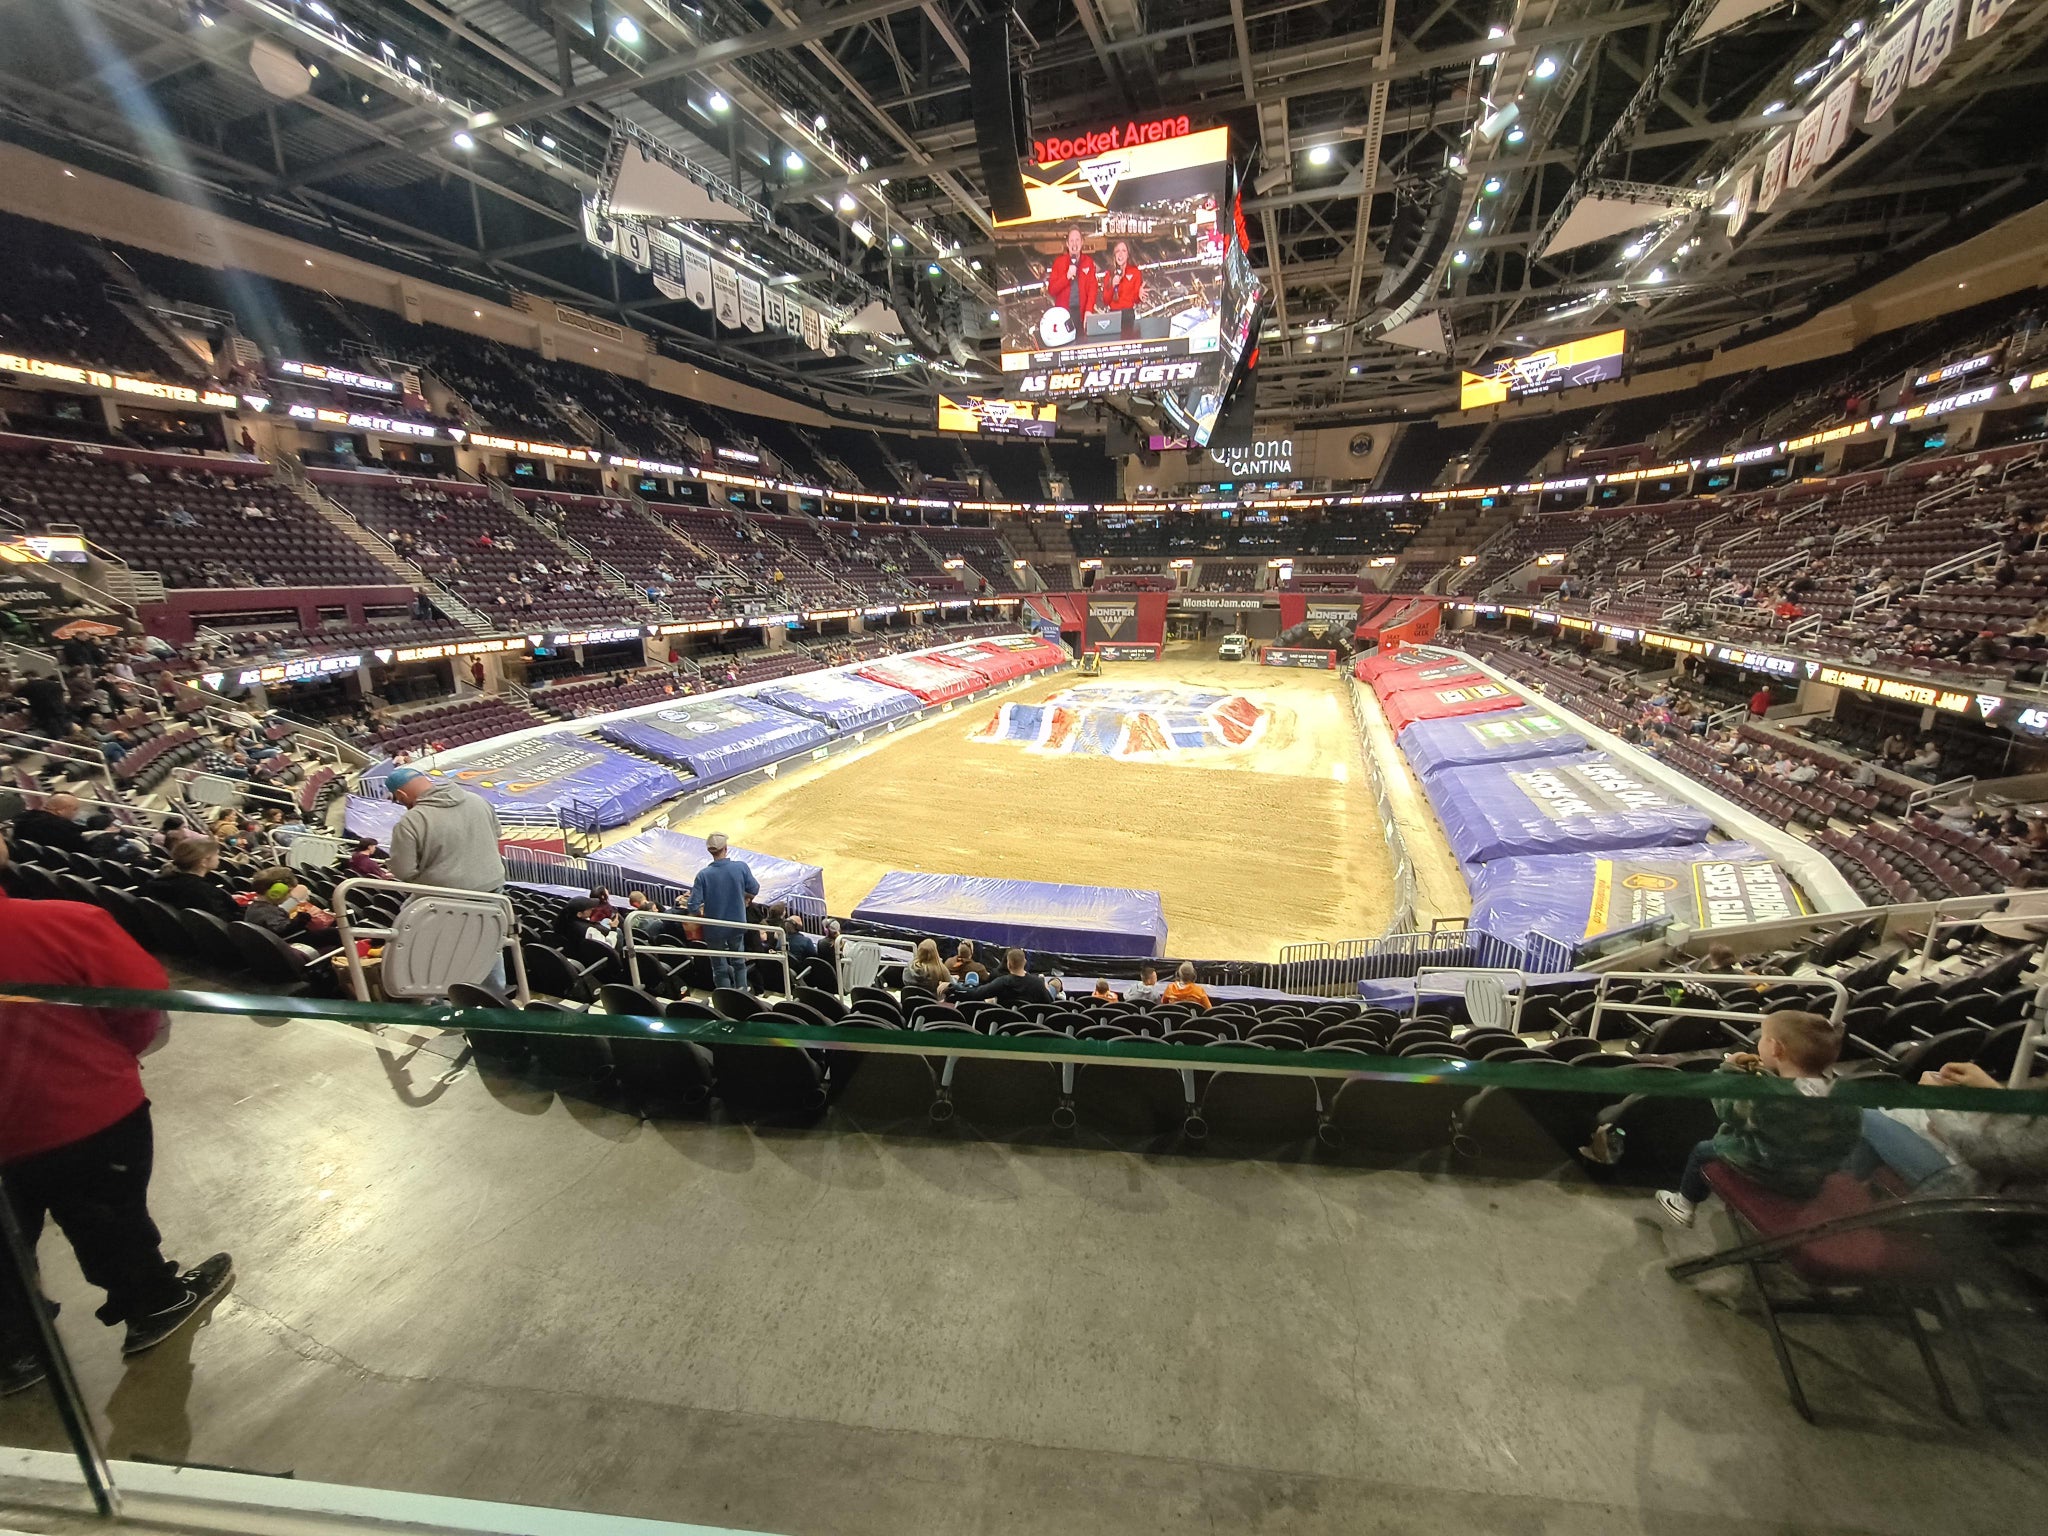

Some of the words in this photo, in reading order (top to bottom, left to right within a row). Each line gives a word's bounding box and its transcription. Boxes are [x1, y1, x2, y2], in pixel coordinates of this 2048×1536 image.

[1915, 9, 1954, 73] 25
[1870, 55, 1904, 109] 22
[1046, 125, 1120, 160] Rocket
[1123, 115, 1190, 146] Arena
[630, 235, 640, 259] 9
[768, 301, 782, 324] 15
[788, 312, 801, 333] 27
[1019, 375, 1047, 392] AS
[1049, 372, 1083, 390] BIG
[1084, 370, 1112, 387] AS
[1113, 367, 1136, 385] IT
[1138, 362, 1198, 382] GETS!
[1232, 460, 1292, 476] CANTINA
[1090, 608, 1135, 617] MONSTER
[1183, 598, 1260, 608] MonsterJam.com
[1306, 611, 1358, 621] MONSTER
[1820, 667, 1866, 691] WELCOME
[1866, 677, 1881, 692] TO
[1880, 680, 1936, 706] MONSTER
[1935, 691, 1969, 713] JAM
[470, 753, 498, 766] UTAH
[503, 738, 544, 755] SPORTS
[484, 742, 555, 769] COMMISSION
[548, 749, 585, 766] SPORTS
[534, 752, 597, 781] COMMISSION
[1576, 763, 1643, 791] LUCAS
[1615, 790, 1668, 810] OIL
[1702, 864, 1742, 898] SUPER
[1741, 863, 1778, 884] THE
[1708, 899, 1748, 928] GLU
